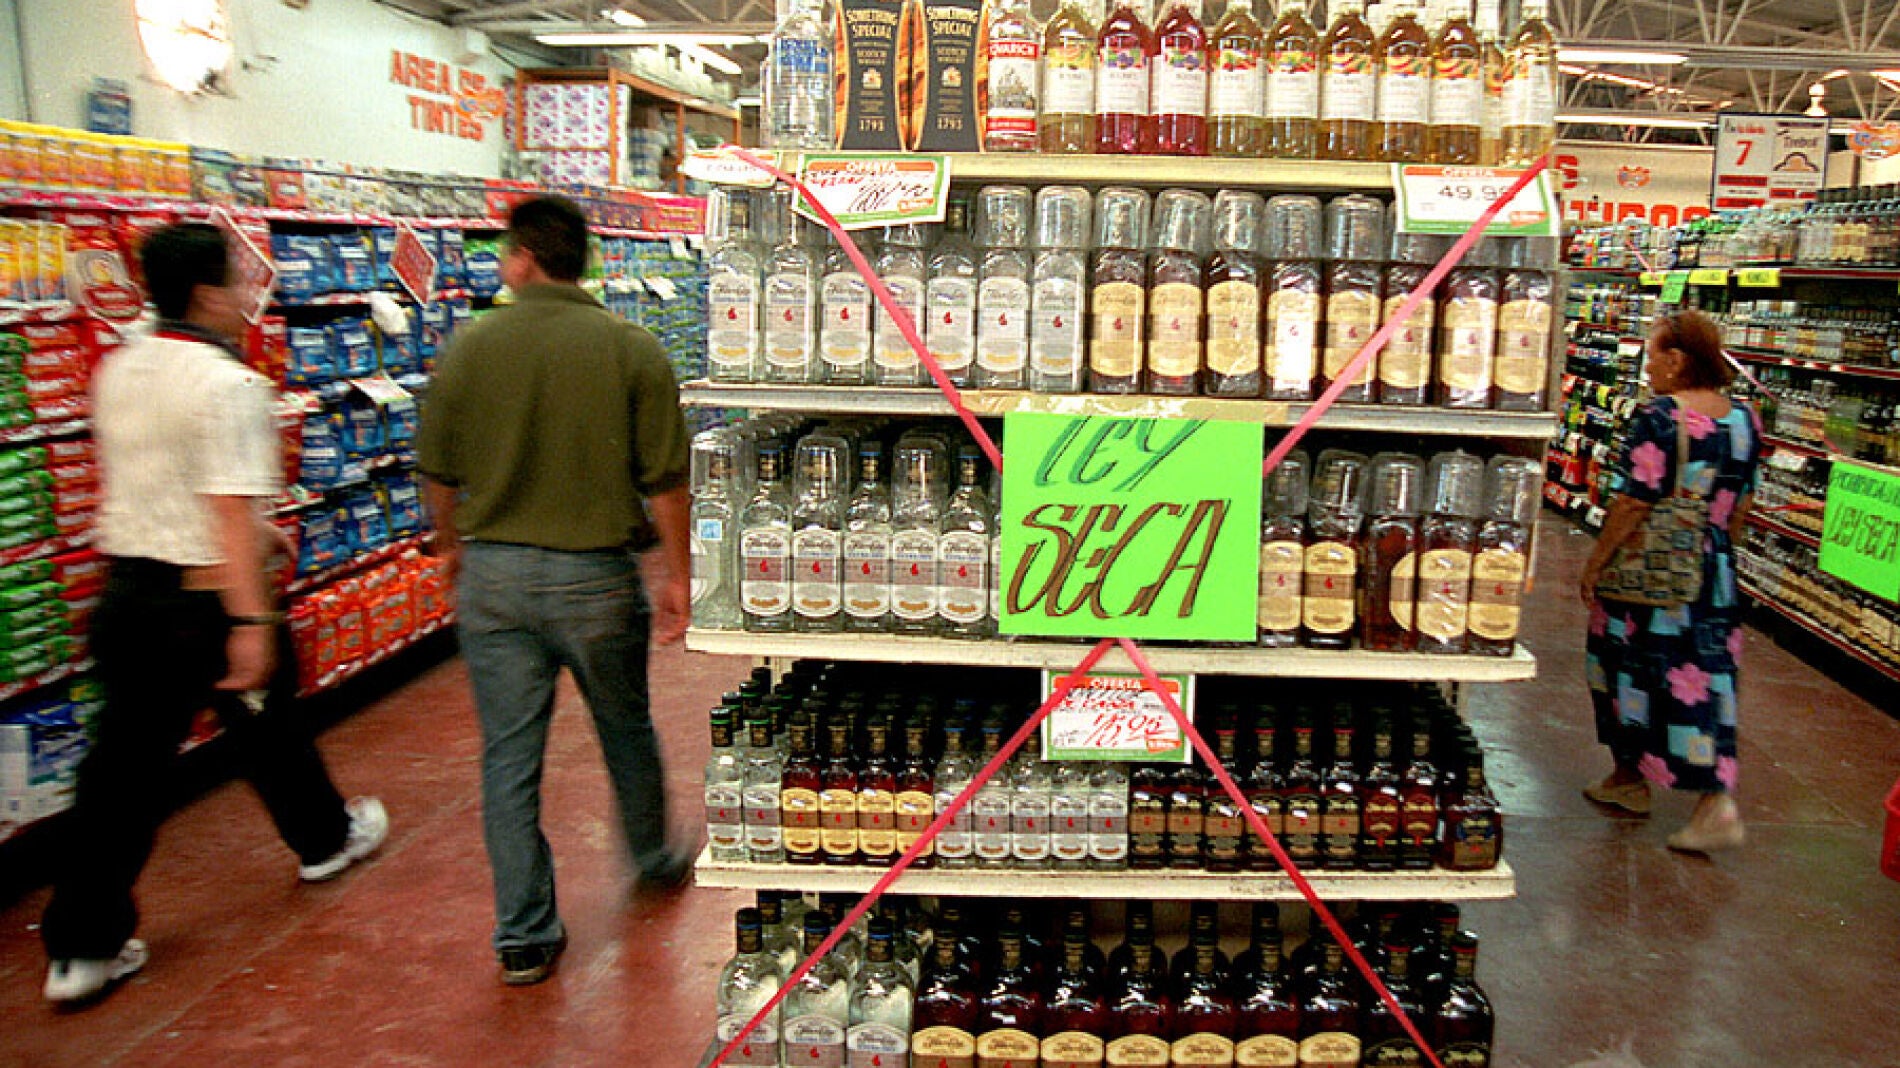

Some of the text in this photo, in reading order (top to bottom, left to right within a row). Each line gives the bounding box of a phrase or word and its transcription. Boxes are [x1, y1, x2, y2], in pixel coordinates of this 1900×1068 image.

[390, 50, 450, 95] AREA
[1735, 140, 1753, 166] 7
[1437, 184, 1510, 202] 49.9
[1006, 498, 1232, 619] SECA
[1090, 678, 1142, 690] OFERTA
